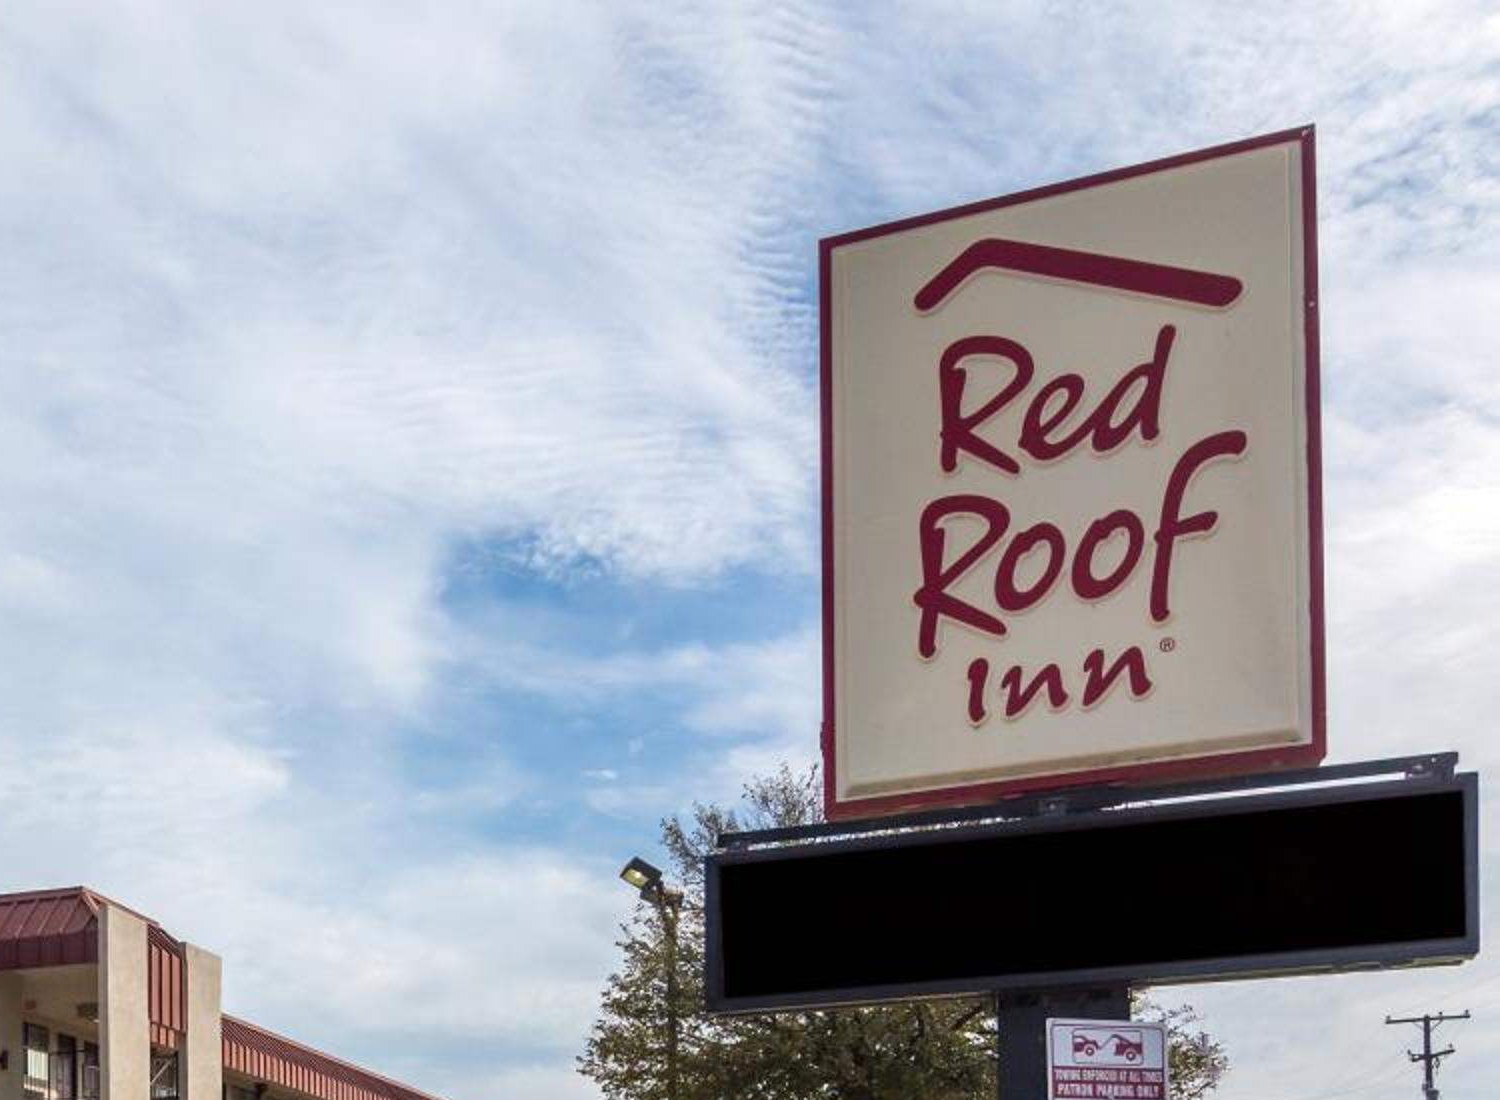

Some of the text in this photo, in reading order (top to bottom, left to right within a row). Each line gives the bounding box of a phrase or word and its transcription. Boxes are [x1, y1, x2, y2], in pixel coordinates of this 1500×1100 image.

[939, 323, 1176, 474] Red
[913, 429, 1248, 658] Roof
[1057, 1083, 1159, 1097] PATRON PARKING ONLY
